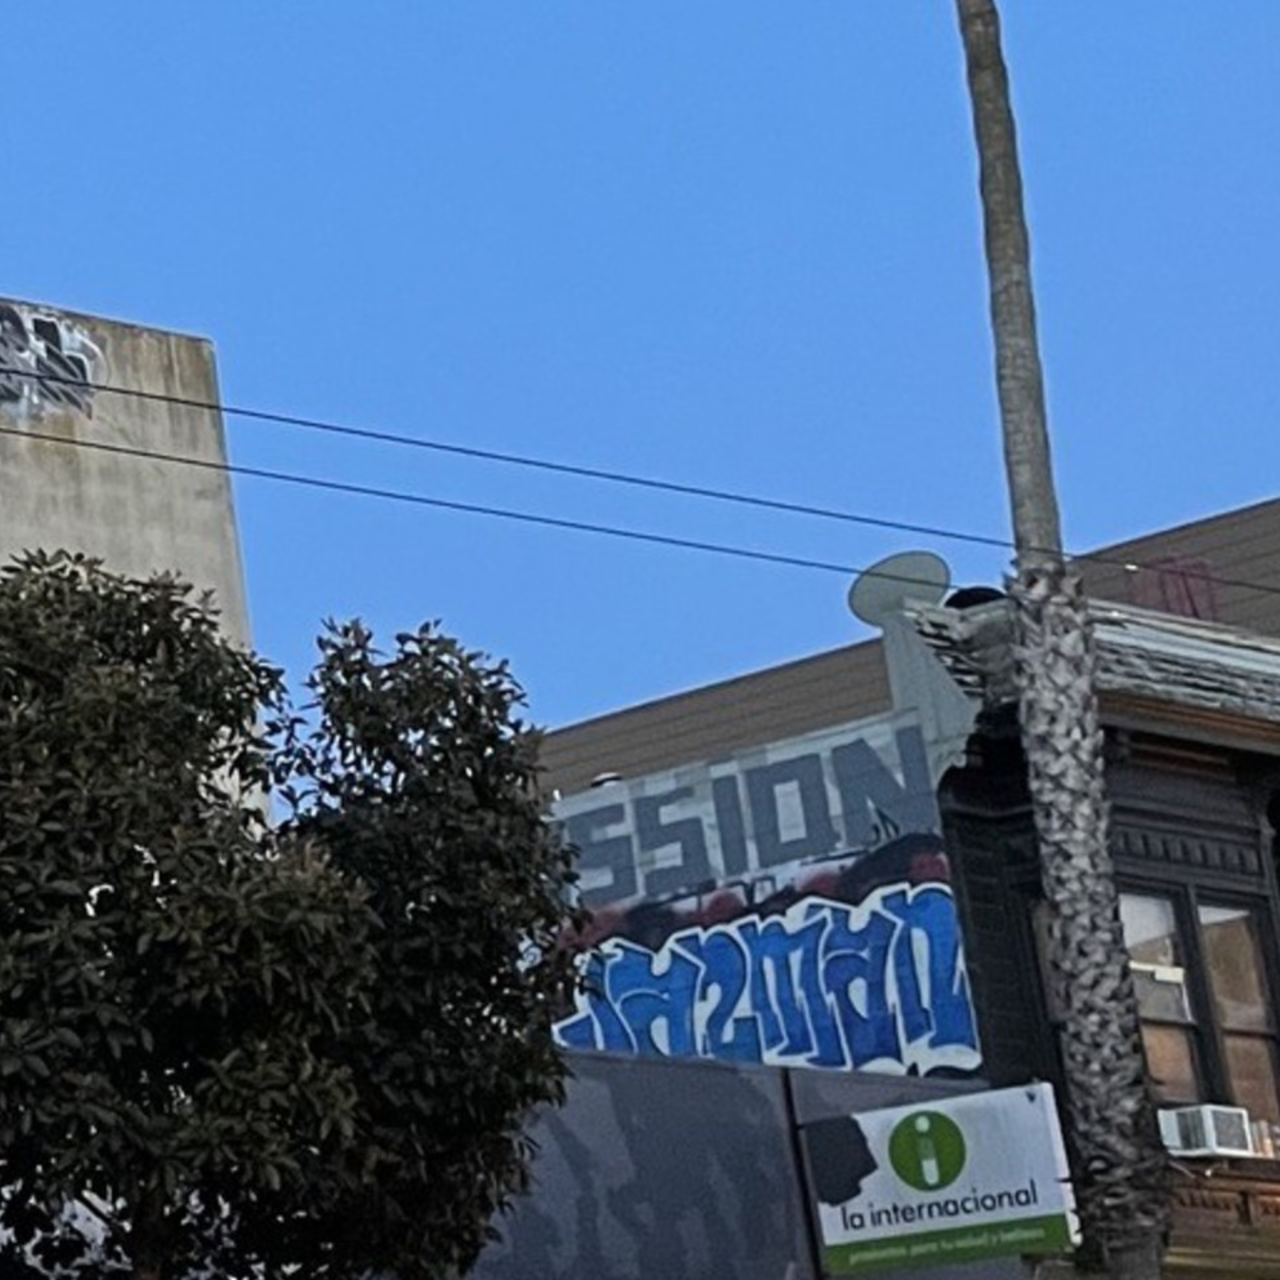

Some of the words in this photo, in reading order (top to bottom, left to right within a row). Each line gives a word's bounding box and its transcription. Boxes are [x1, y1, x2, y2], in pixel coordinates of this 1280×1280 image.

[564, 724, 938, 910] SSION
[841, 1206, 865, 1231] la
[870, 1179, 1039, 1227] internacional
